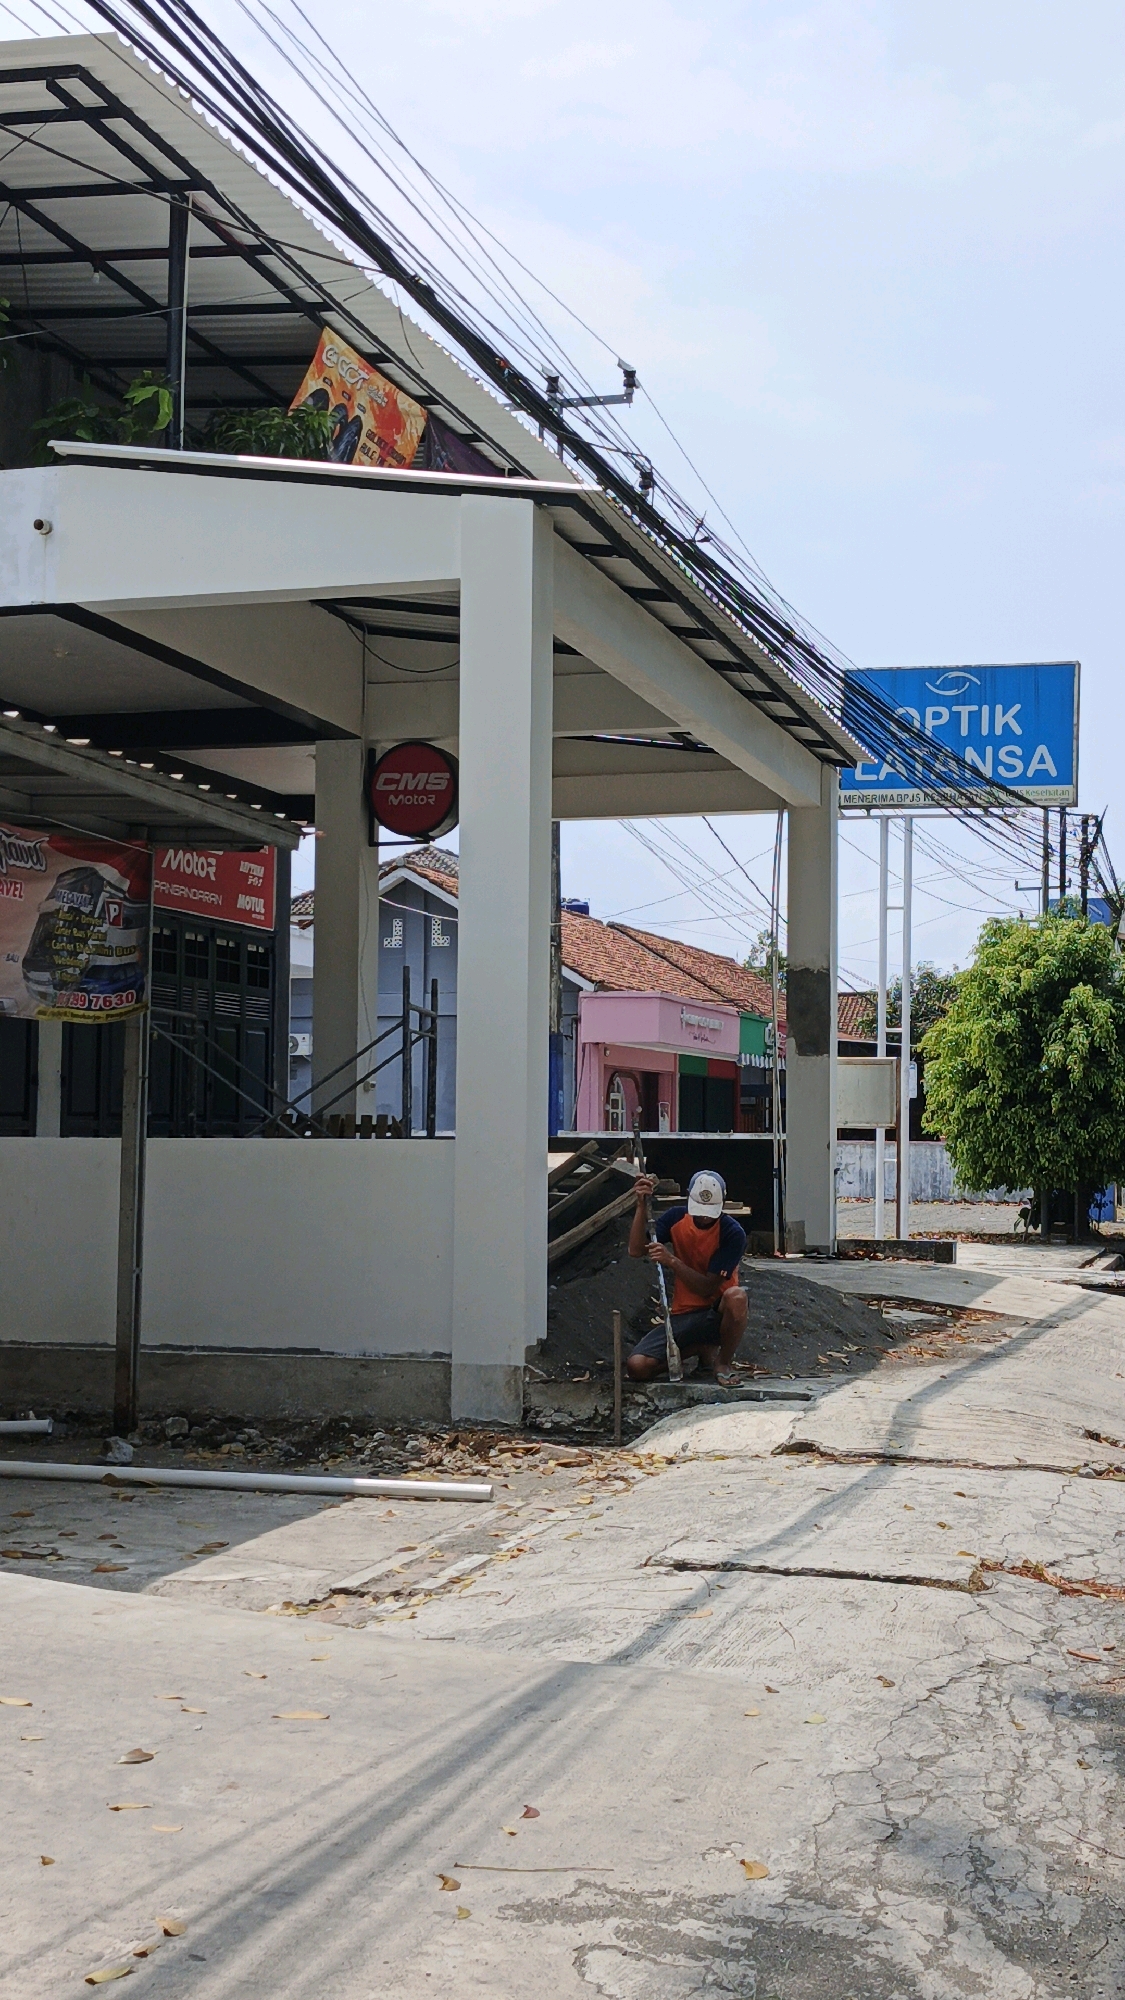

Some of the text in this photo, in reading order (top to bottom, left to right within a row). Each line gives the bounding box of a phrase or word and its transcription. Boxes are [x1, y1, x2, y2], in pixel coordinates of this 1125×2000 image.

[889, 703, 1023, 737] OPTIK
[375, 772, 450, 791] CMS
[843, 793, 896, 804] MENERIMA
[897, 792, 921, 803] BPJS
[1025, 788, 1070, 797] Kesehatan
[154, 879, 222, 906] PANGANDARAN
[237, 893, 265, 914] MOTUL
[116, 946, 136, 956] Bus
[90, 990, 136, 1009] 7630
